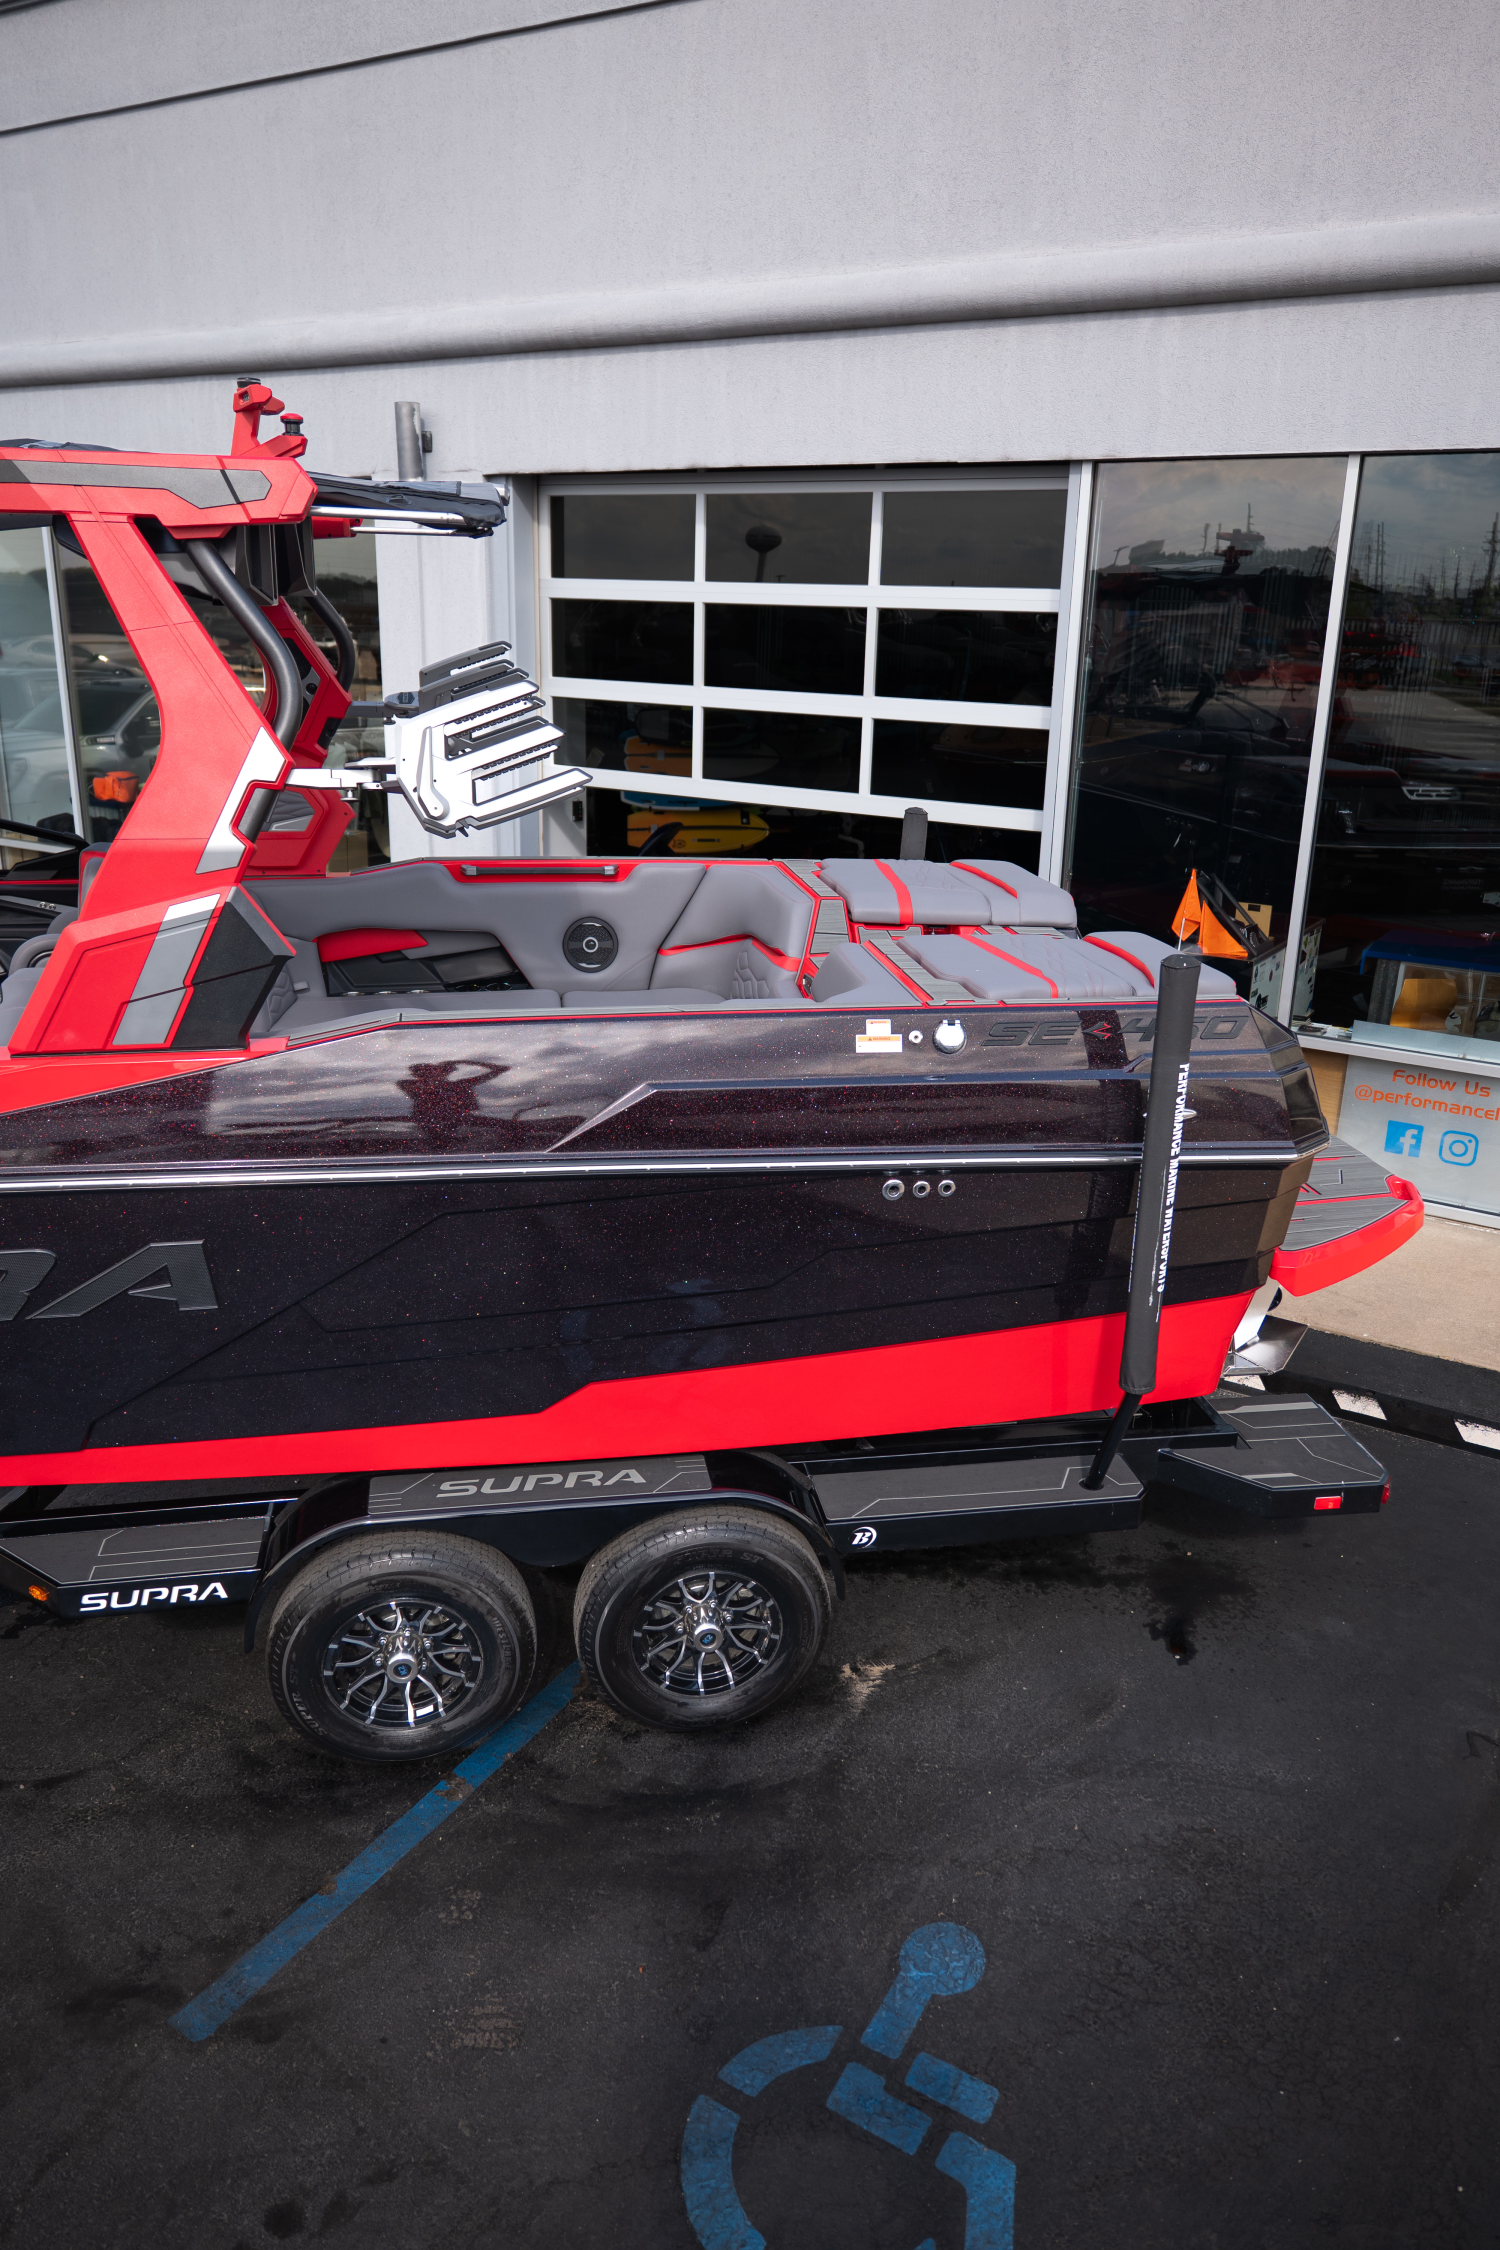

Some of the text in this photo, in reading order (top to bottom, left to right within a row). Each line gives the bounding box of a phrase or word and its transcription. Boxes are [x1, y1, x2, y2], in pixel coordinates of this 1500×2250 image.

[981, 1015, 1250, 1046] SE 40
[1392, 1069, 1491, 1098] Follow Us
[436, 1469, 647, 1498] SUPRA
[79, 1582, 229, 1612] SUPRA
